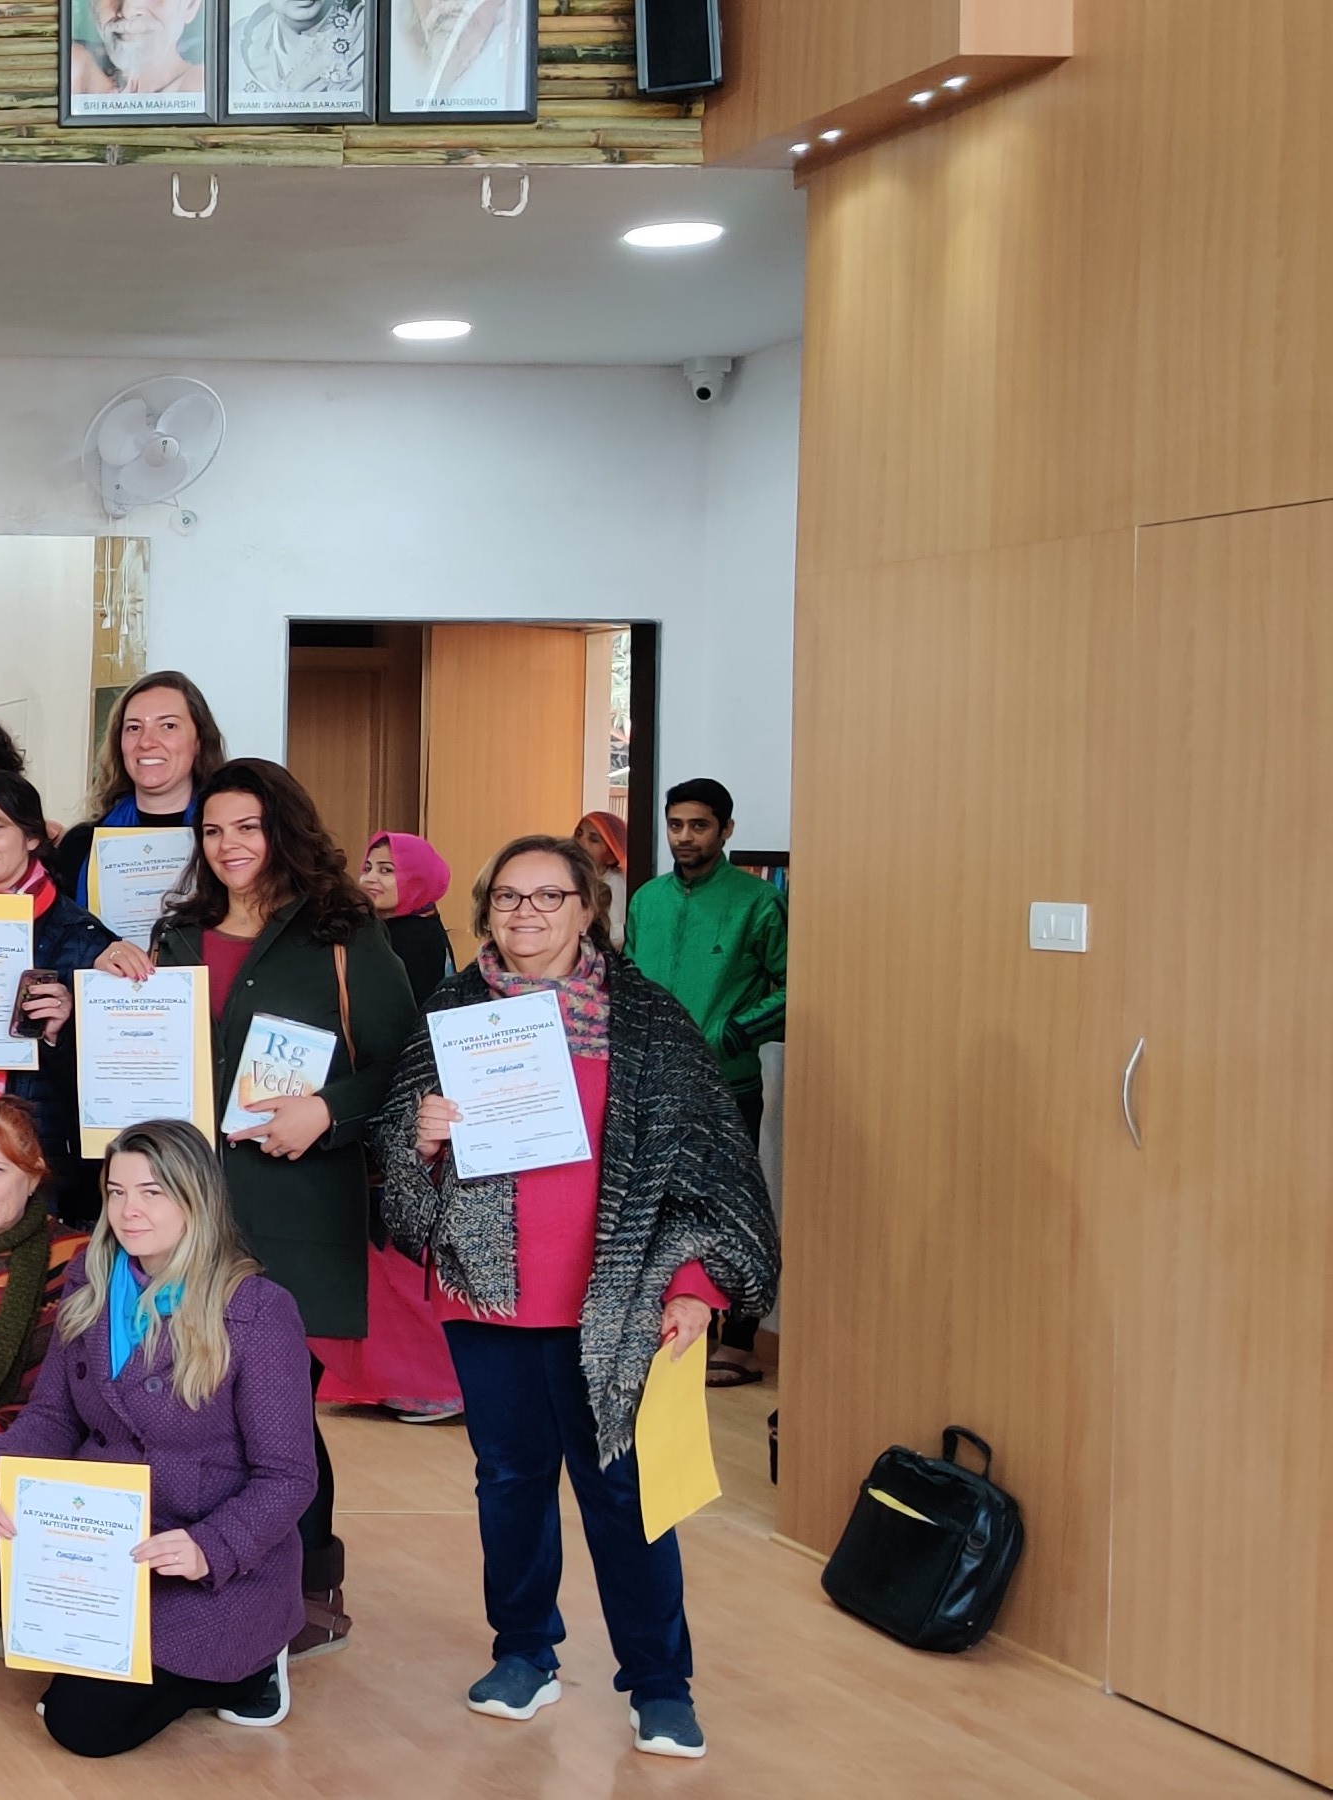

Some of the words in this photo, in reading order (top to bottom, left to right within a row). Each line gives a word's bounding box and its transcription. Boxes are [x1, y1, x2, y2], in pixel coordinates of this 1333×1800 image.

[84, 102, 100, 110] SRI
[102, 101, 143, 110] RAMANA
[146, 100, 196, 109] MAHARSHI
[313, 100, 361, 108] SARASWATI
[440, 98, 498, 106] AUROBINDO
[443, 1034, 490, 1048] ARYAVRATA
[491, 1021, 554, 1038] INTERNATIONAL
[462, 1039, 501, 1051] INSTITUTE
[516, 1032, 537, 1041] YOGA
[486, 1063, 524, 1075] Certificate
[251, 1060, 304, 1097] Veda
